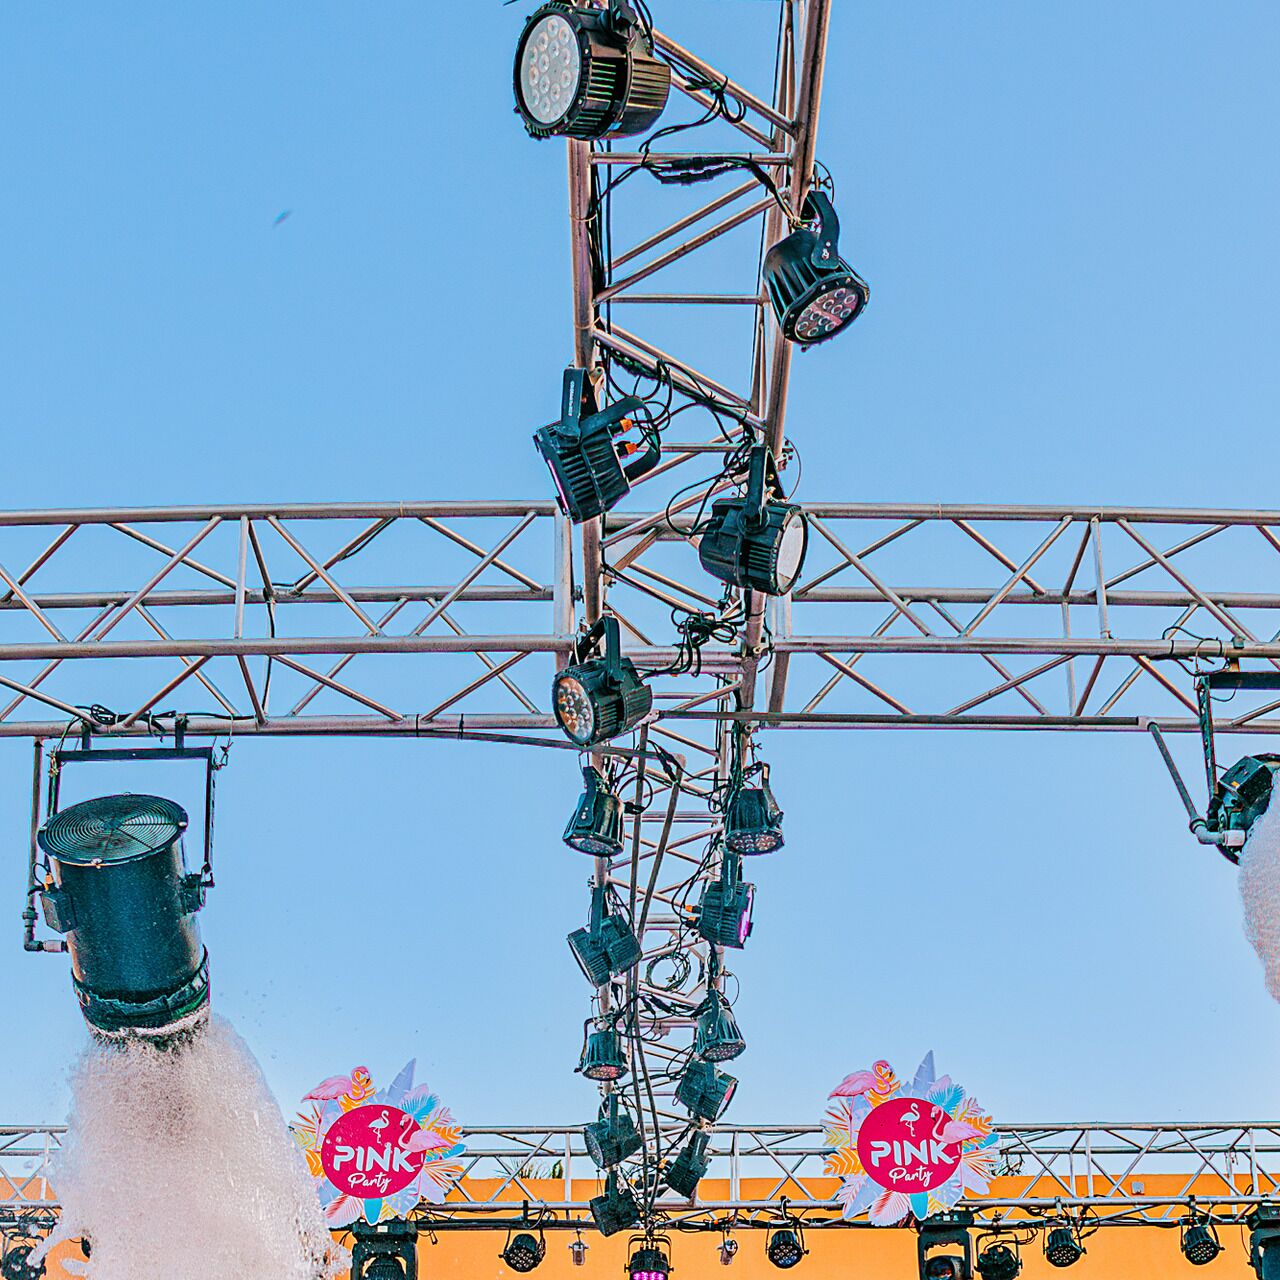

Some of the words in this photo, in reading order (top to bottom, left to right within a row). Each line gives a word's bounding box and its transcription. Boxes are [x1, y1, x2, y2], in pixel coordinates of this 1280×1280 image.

[333, 1145, 415, 1172] PINK
[870, 1139, 954, 1167] PINK
[347, 1171, 391, 1193] Party
[888, 1165, 933, 1187] Party
